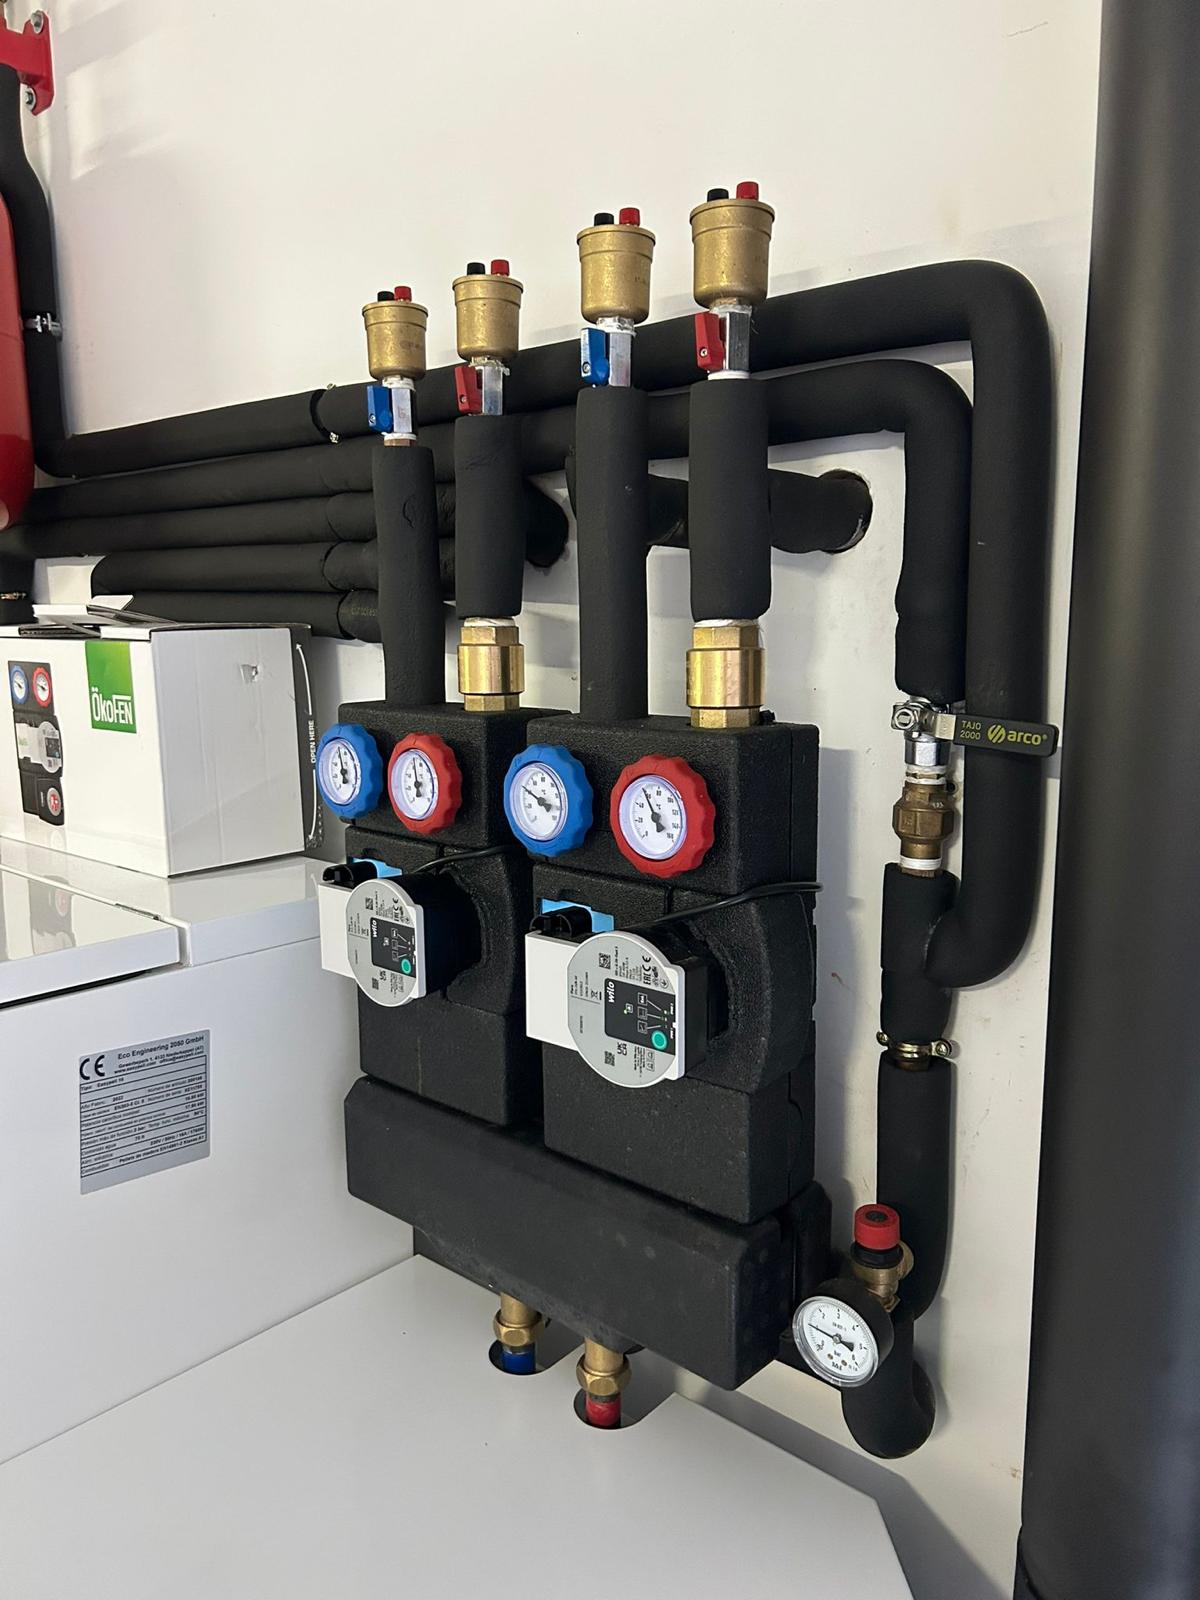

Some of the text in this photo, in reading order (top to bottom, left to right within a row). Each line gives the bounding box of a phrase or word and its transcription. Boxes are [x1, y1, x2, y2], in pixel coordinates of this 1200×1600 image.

[961, 720, 981, 730] TAJO
[960, 730, 981, 740] 2000
[1007, 730, 1042, 745] arco
[642, 955, 651, 972] CE
[606, 981, 615, 1003] wilo
[132, 1043, 168, 1056] Engineering
[185, 1036, 204, 1045] GmbH
[79, 1054, 105, 1080] CE
